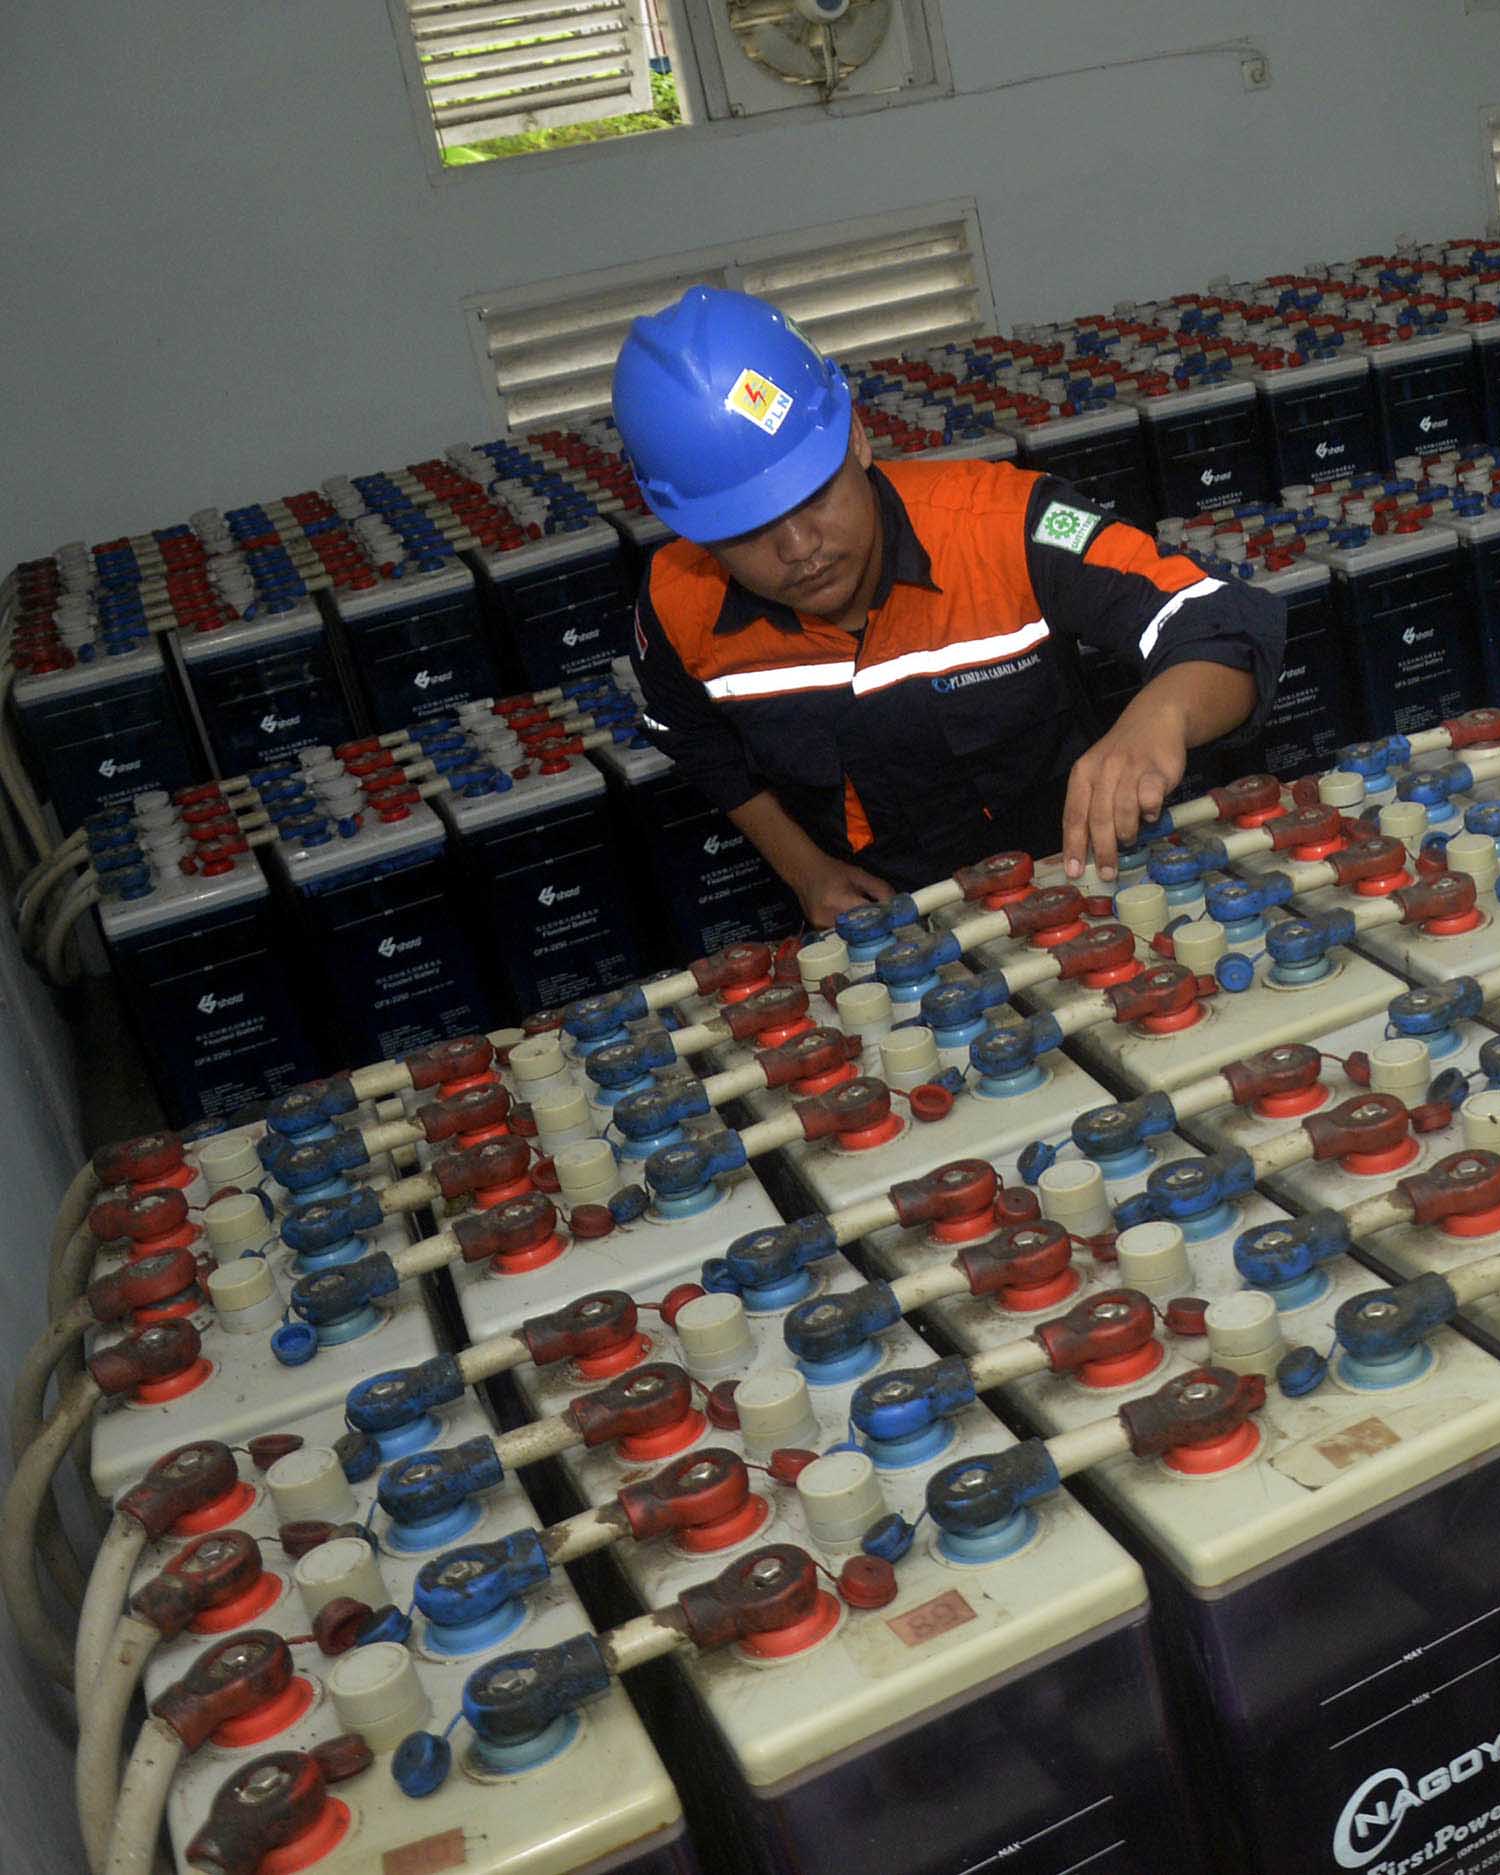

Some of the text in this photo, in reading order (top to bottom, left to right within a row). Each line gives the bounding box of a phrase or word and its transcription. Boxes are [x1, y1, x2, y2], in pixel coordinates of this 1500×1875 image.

[765, 394, 791, 431] PLN
[1402, 1647, 1424, 1662] MAX
[1411, 1691, 1431, 1706] MIN
[998, 1842, 1021, 1859] MAX
